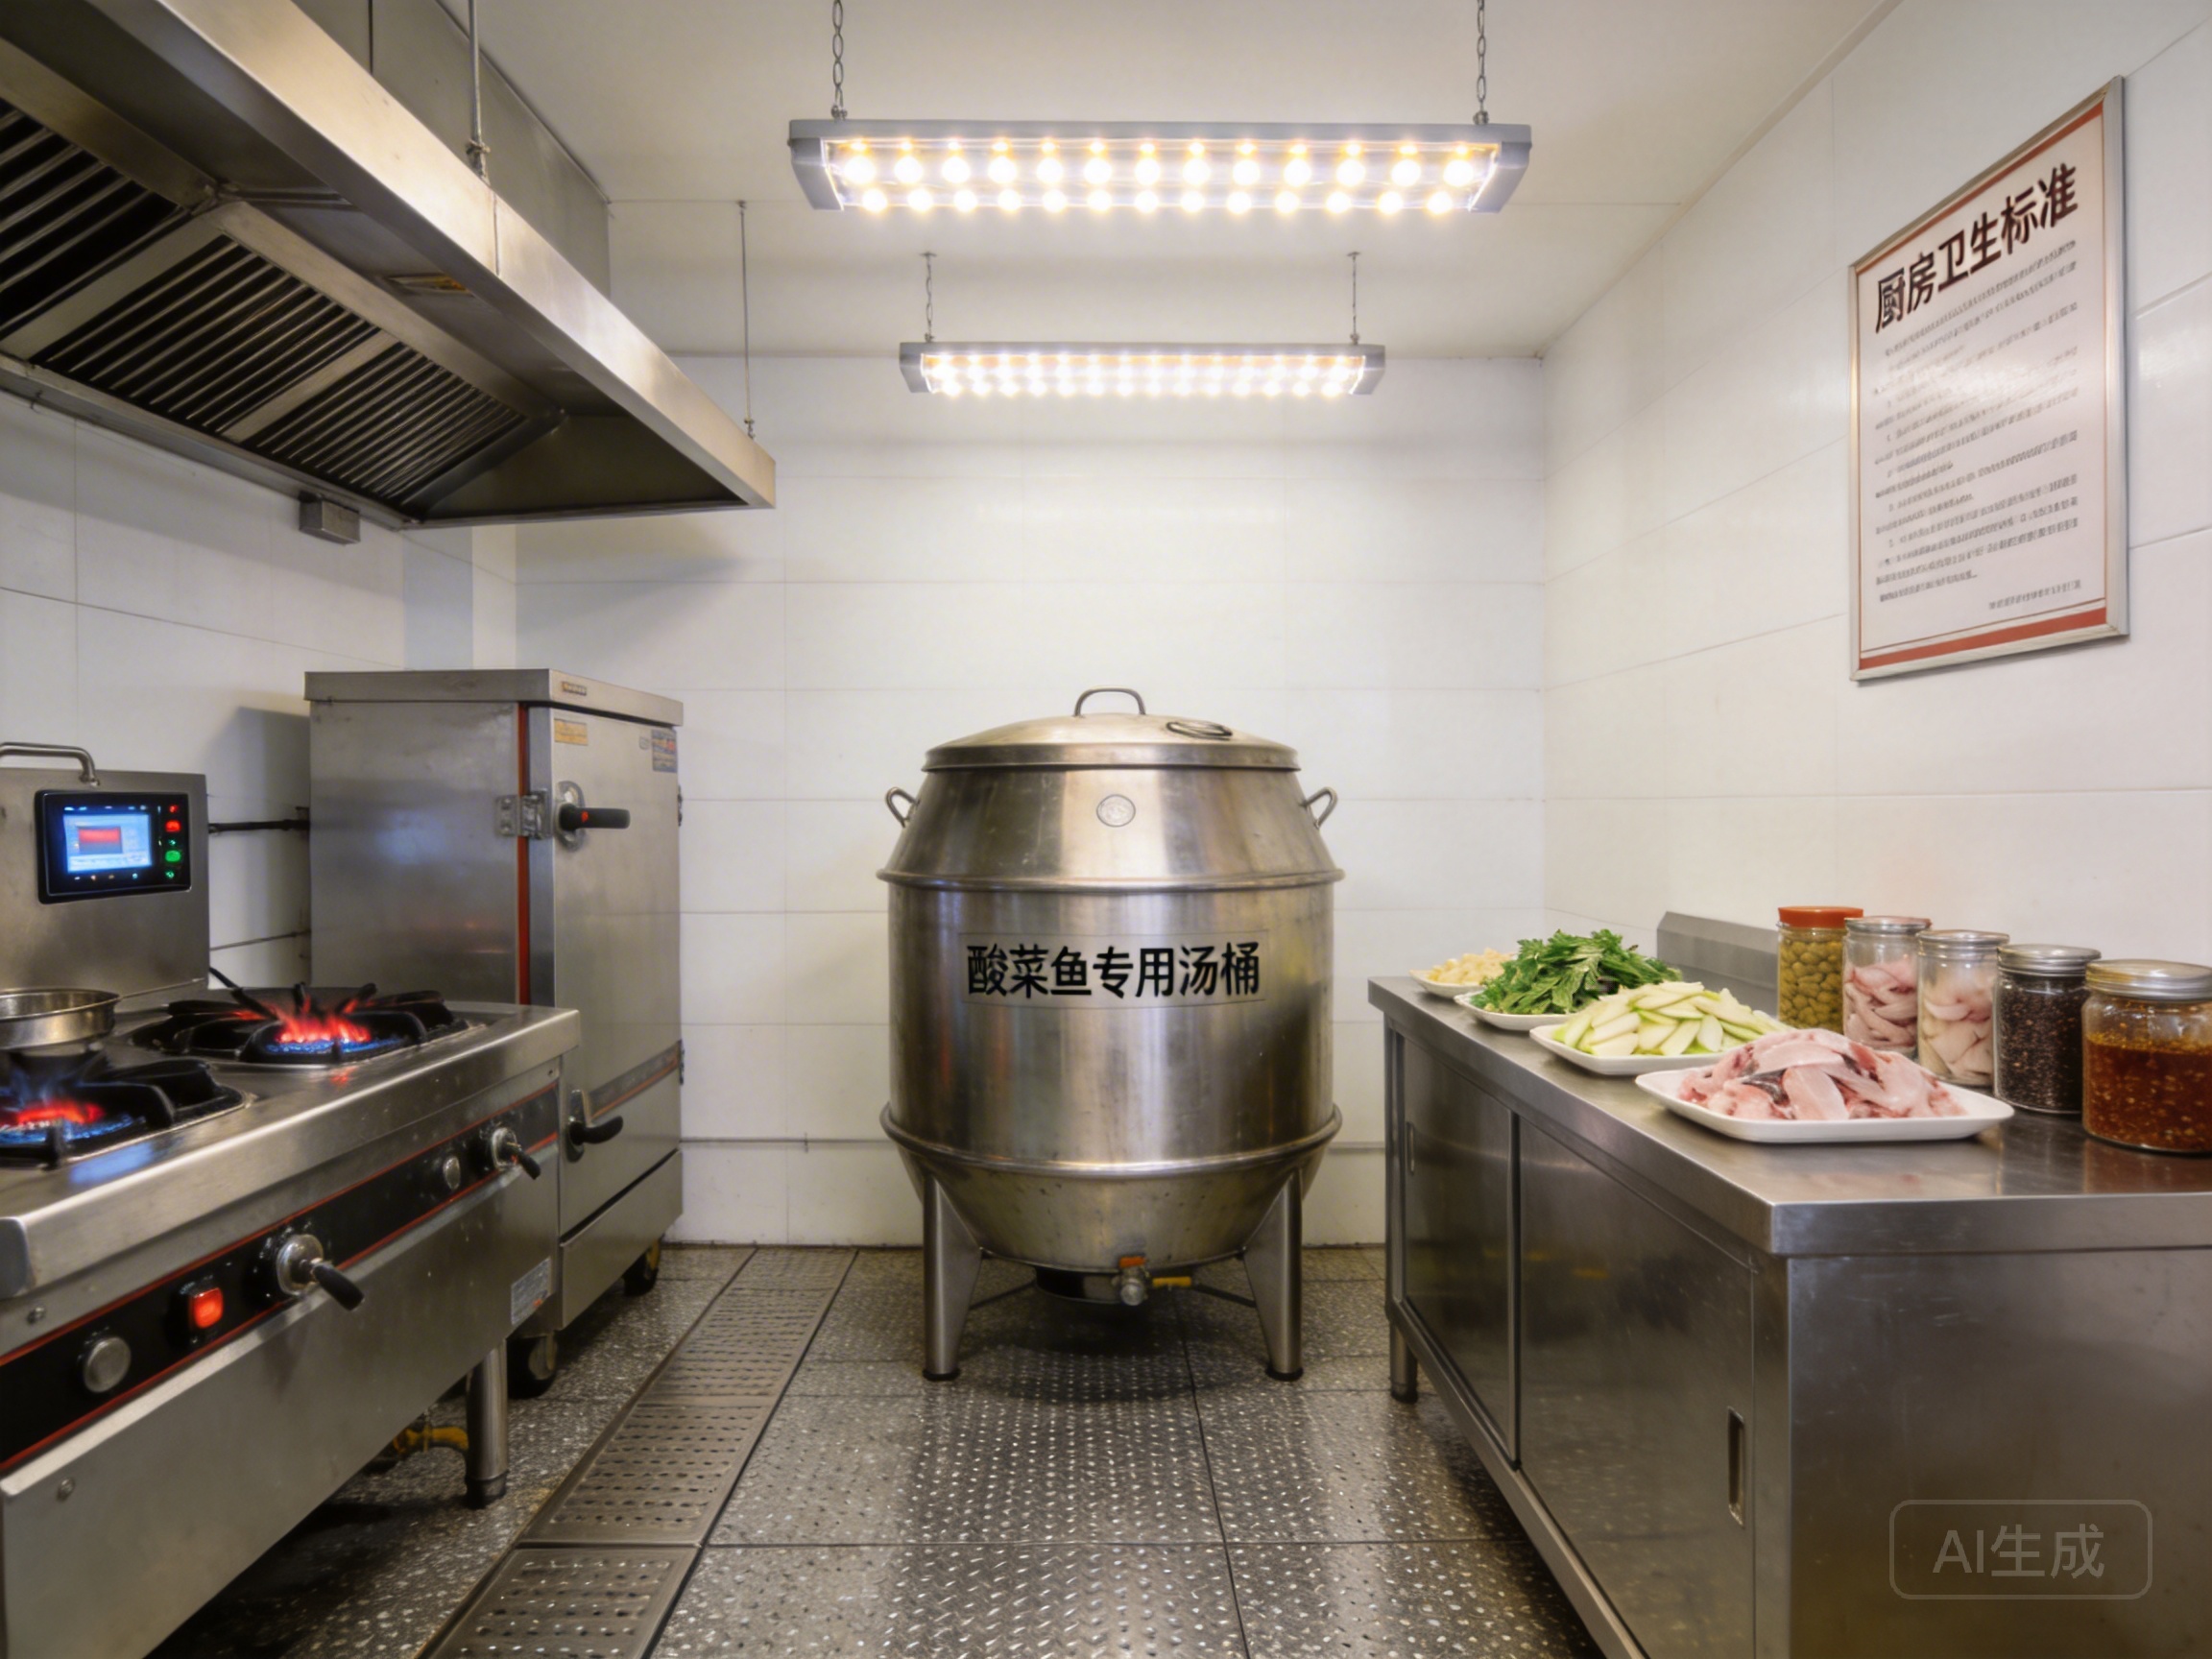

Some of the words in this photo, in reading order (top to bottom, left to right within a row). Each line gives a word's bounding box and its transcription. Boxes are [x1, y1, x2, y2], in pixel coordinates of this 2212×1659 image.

[1875, 162, 2079, 333] 厨房卫生标准
[967, 942, 1260, 998] 酸菜鱼专用汤桶
